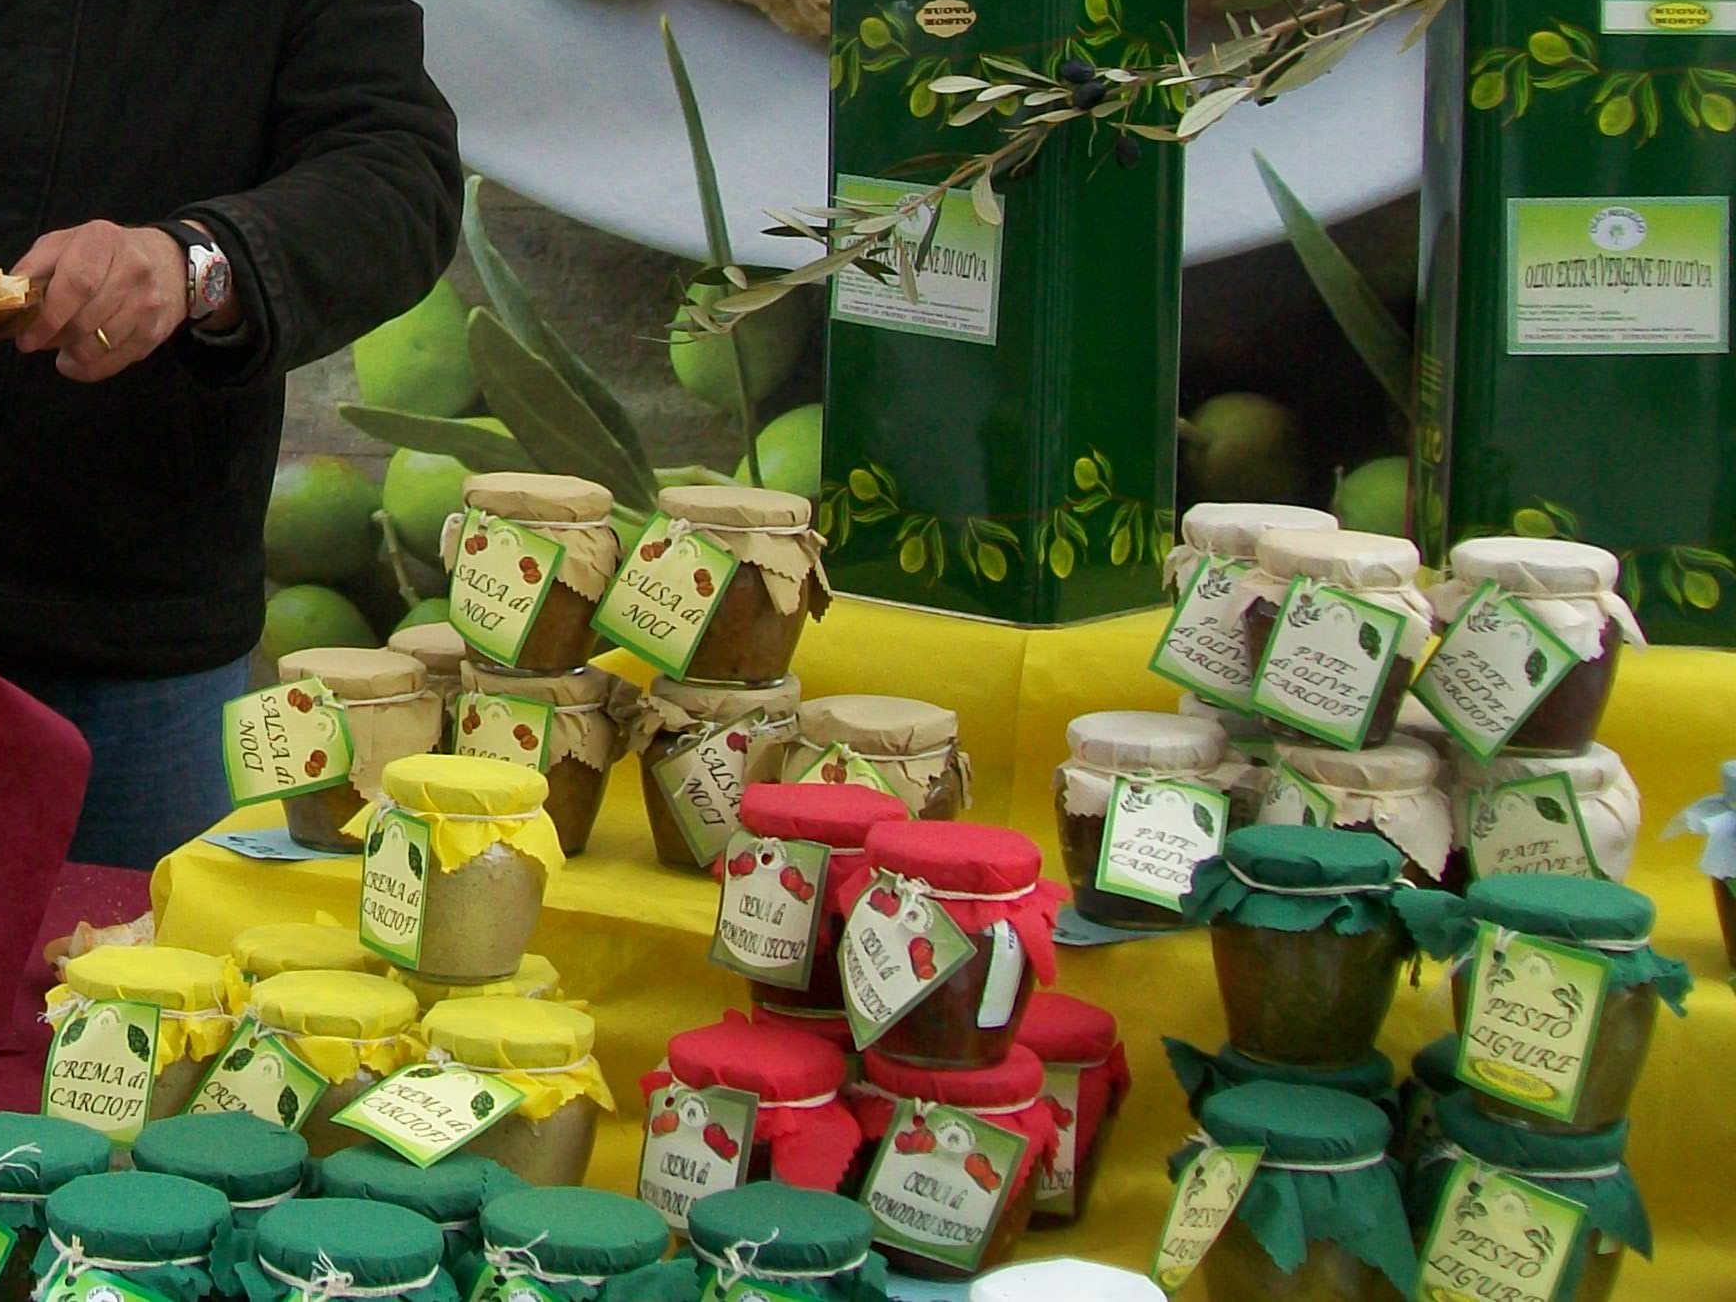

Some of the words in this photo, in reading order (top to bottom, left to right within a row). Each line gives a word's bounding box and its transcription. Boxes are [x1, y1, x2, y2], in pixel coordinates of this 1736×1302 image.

[456, 564, 510, 603] SALSA
[509, 595, 535, 614] di
[620, 569, 683, 614] SALSA
[680, 608, 706, 627] di
[459, 598, 506, 632] NOCI
[621, 603, 677, 640] NOCI
[1292, 666, 1358, 698] OLIVE
[1454, 668, 1508, 714] OLIVE
[239, 718, 264, 773] NOCI
[260, 694, 290, 760] SALSA
[275, 765, 297, 786] di
[684, 777, 725, 826] NOCI
[364, 870, 406, 903] CREMA
[407, 889, 422, 908] di
[739, 893, 774, 924] CREMA
[363, 896, 419, 937] CARCIOFI
[1482, 997, 1574, 1040] PESTO
[1469, 1025, 1581, 1074] LIGURE
[51, 1060, 125, 1087] CREMA
[127, 1070, 149, 1092] di
[49, 1085, 145, 1120] CARCIOFI
[361, 1094, 454, 1146] CARCIOFI
[380, 1081, 455, 1121] CREMA
[448, 1115, 475, 1136] di
[660, 1152, 697, 1183] CREMA
[903, 1171, 953, 1204] CREMA
[1451, 1229, 1543, 1280] PESTO
